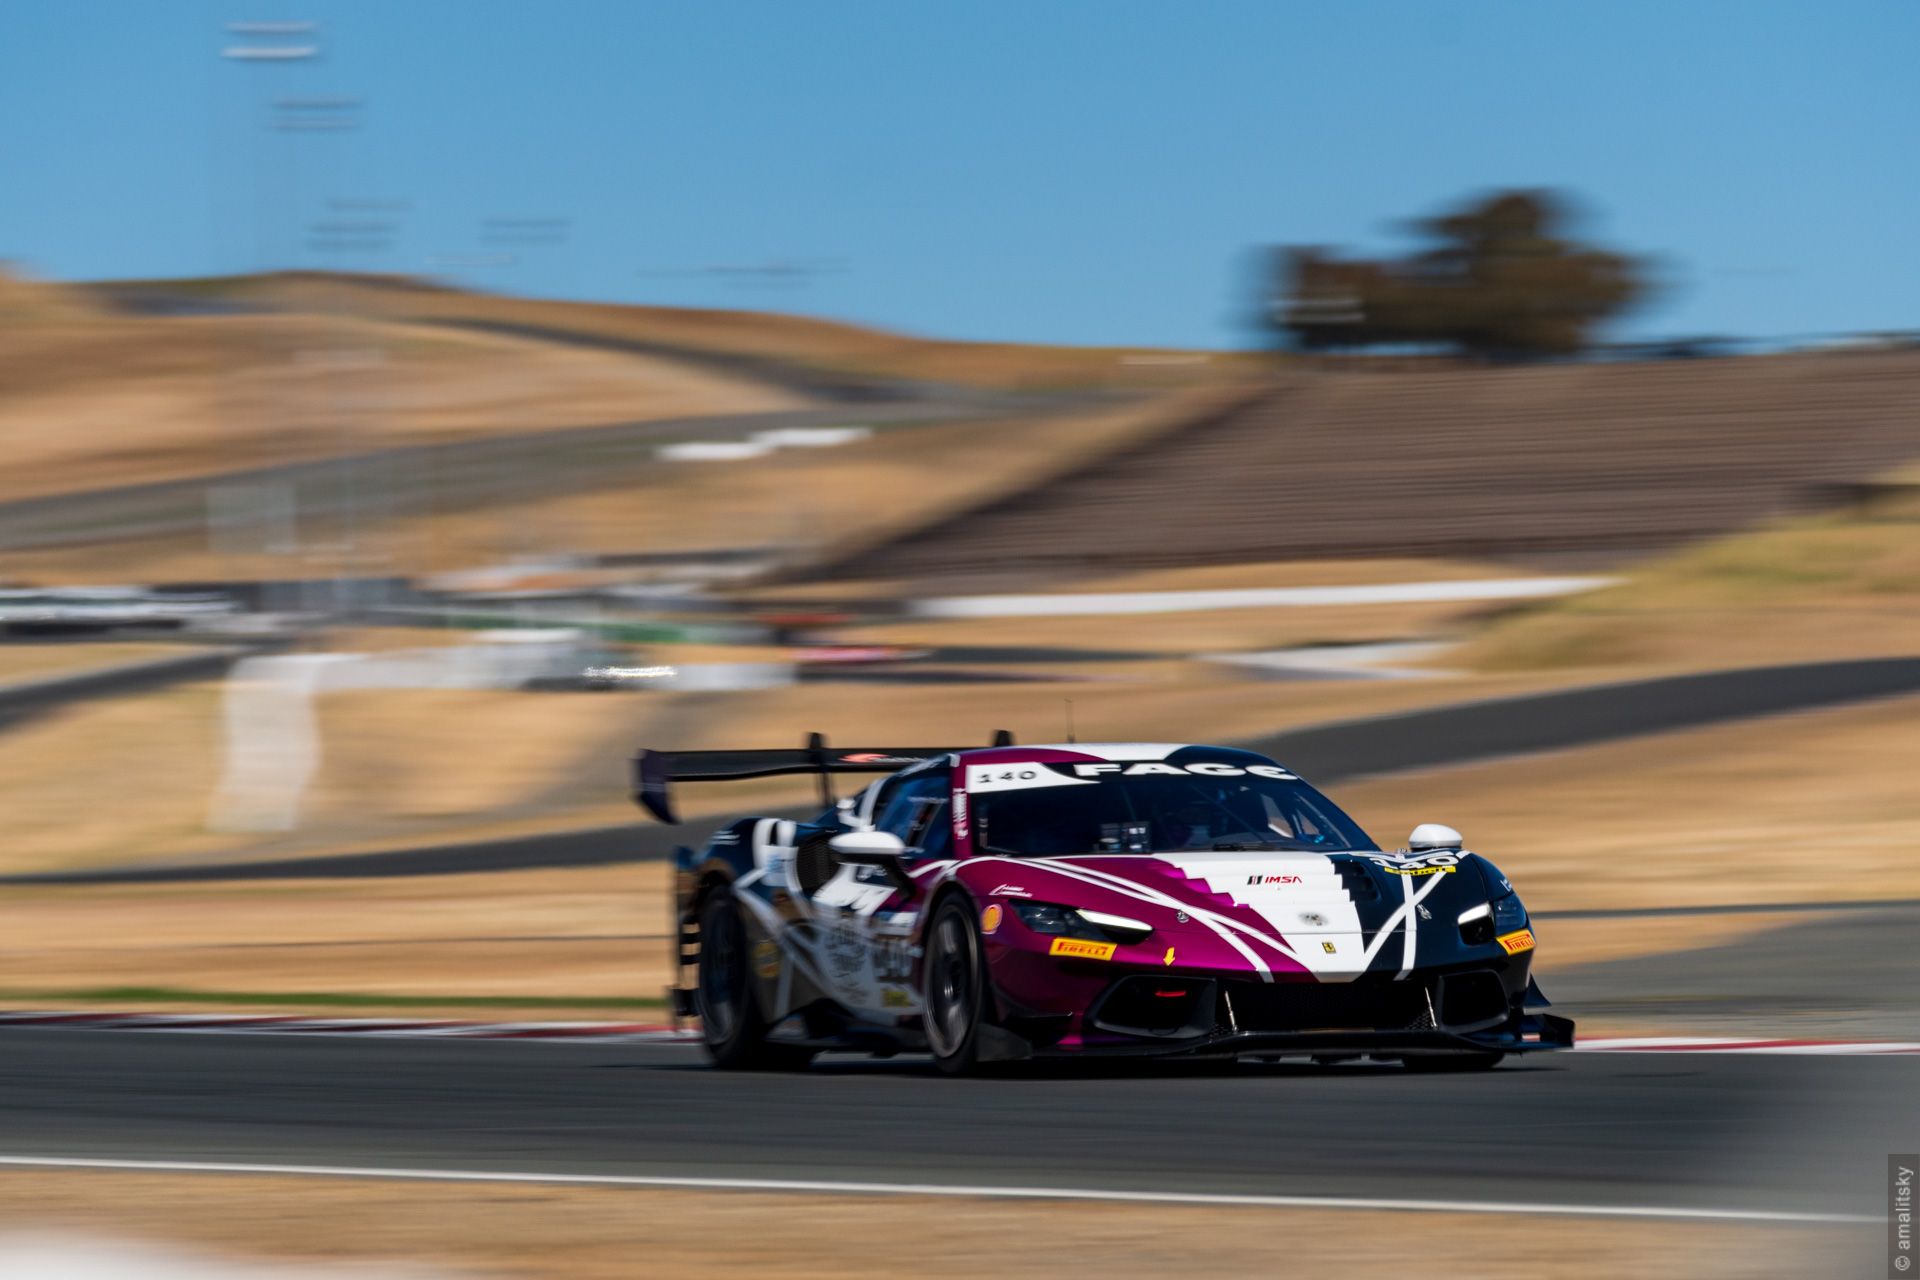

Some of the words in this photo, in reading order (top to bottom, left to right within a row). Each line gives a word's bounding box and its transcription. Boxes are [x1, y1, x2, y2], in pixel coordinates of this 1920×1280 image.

[976, 770, 1037, 783] 140
[1264, 876, 1302, 884] IMSA
[1056, 941, 1109, 956] PIRELLI
